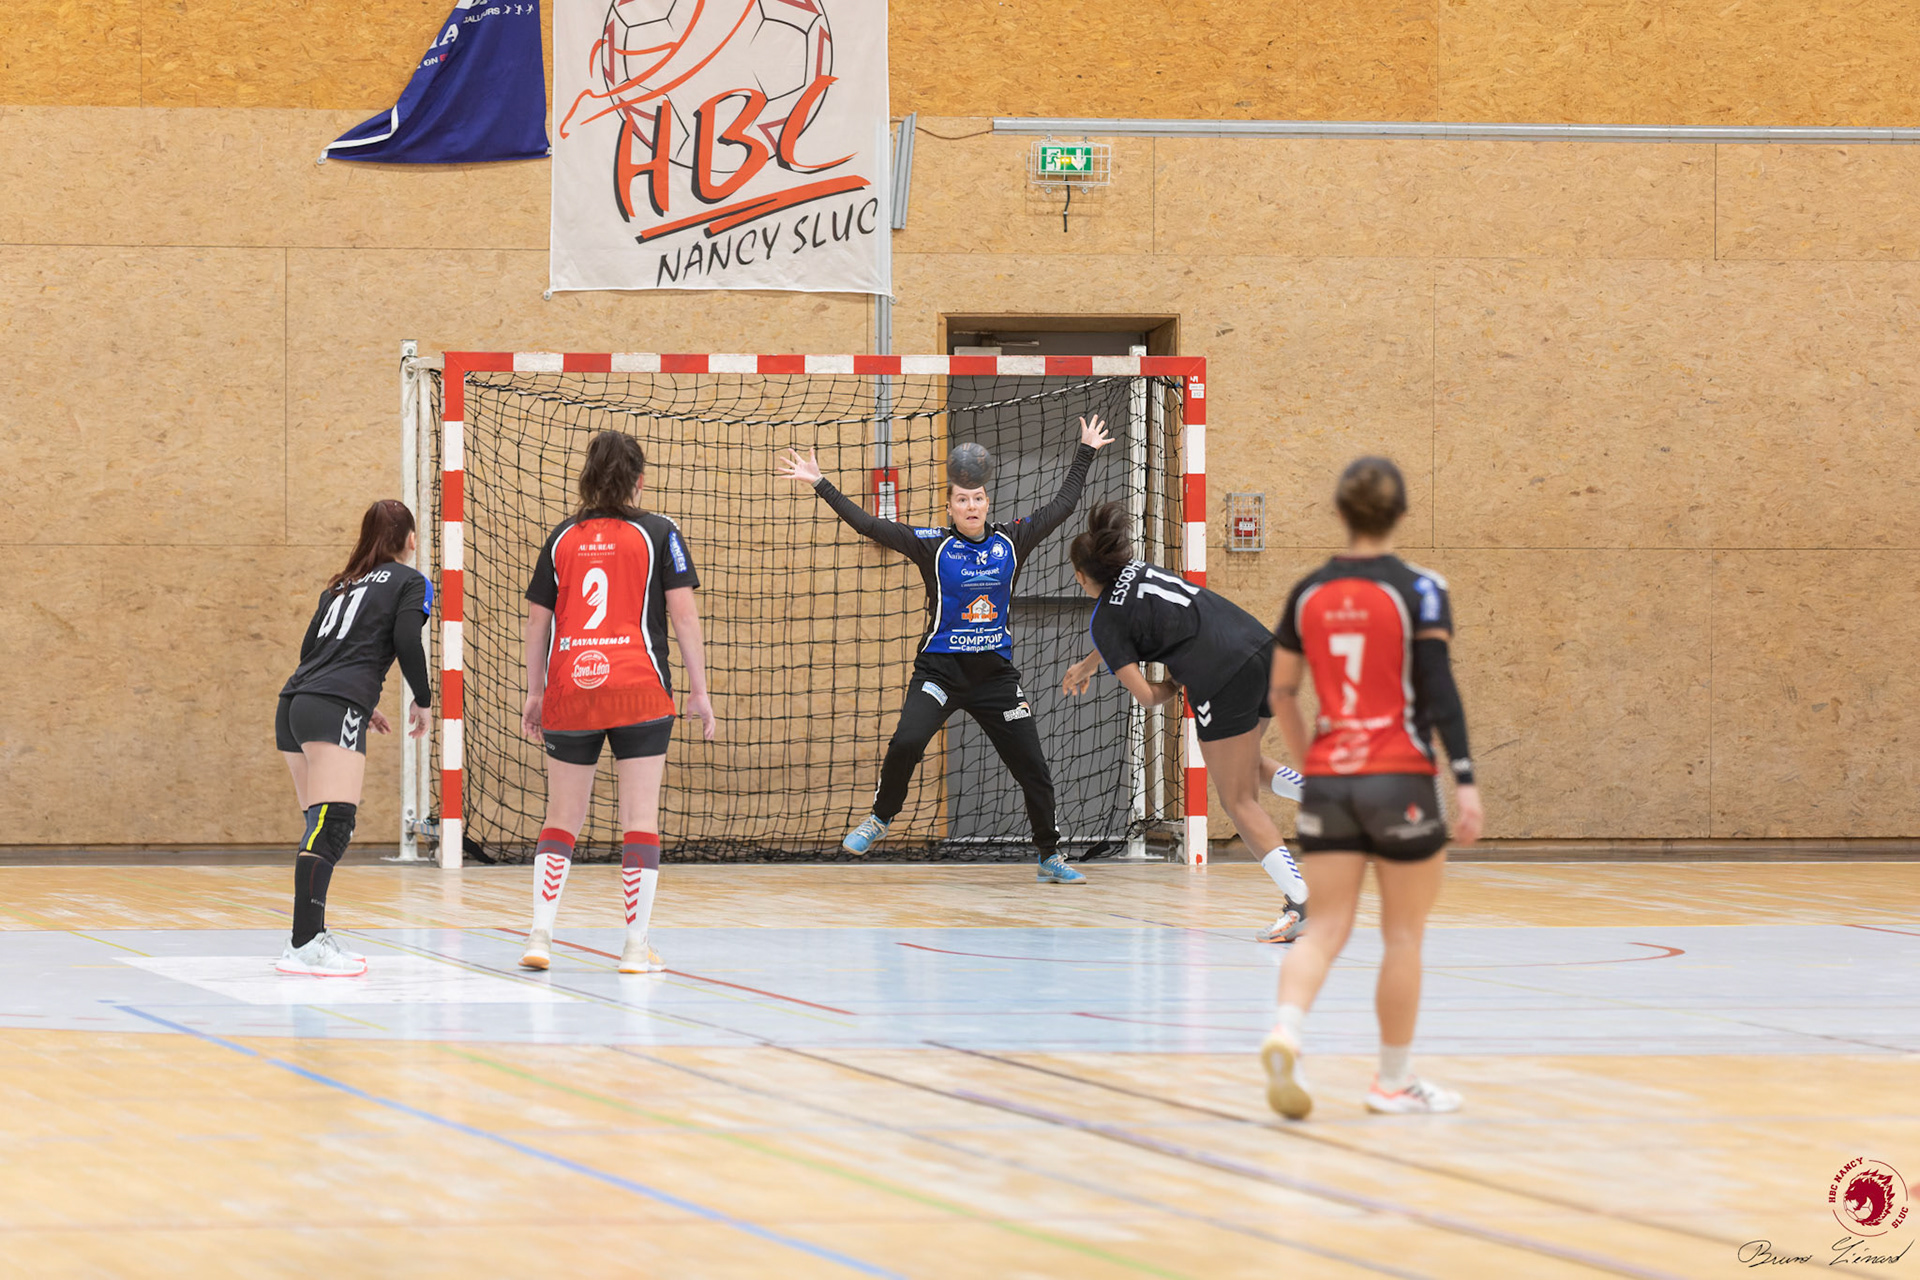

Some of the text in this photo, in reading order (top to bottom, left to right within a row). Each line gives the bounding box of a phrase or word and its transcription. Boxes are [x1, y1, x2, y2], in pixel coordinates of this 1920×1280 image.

[613, 75, 859, 223] HBC
[656, 197, 878, 287] NANCY SLUC
[582, 567, 608, 630] 9
[961, 567, 1000, 577] Guy Hoquet
[1137, 567, 1201, 608] 11
[949, 633, 1003, 646] COMPTOIR
[1328, 633, 1366, 716] 7
